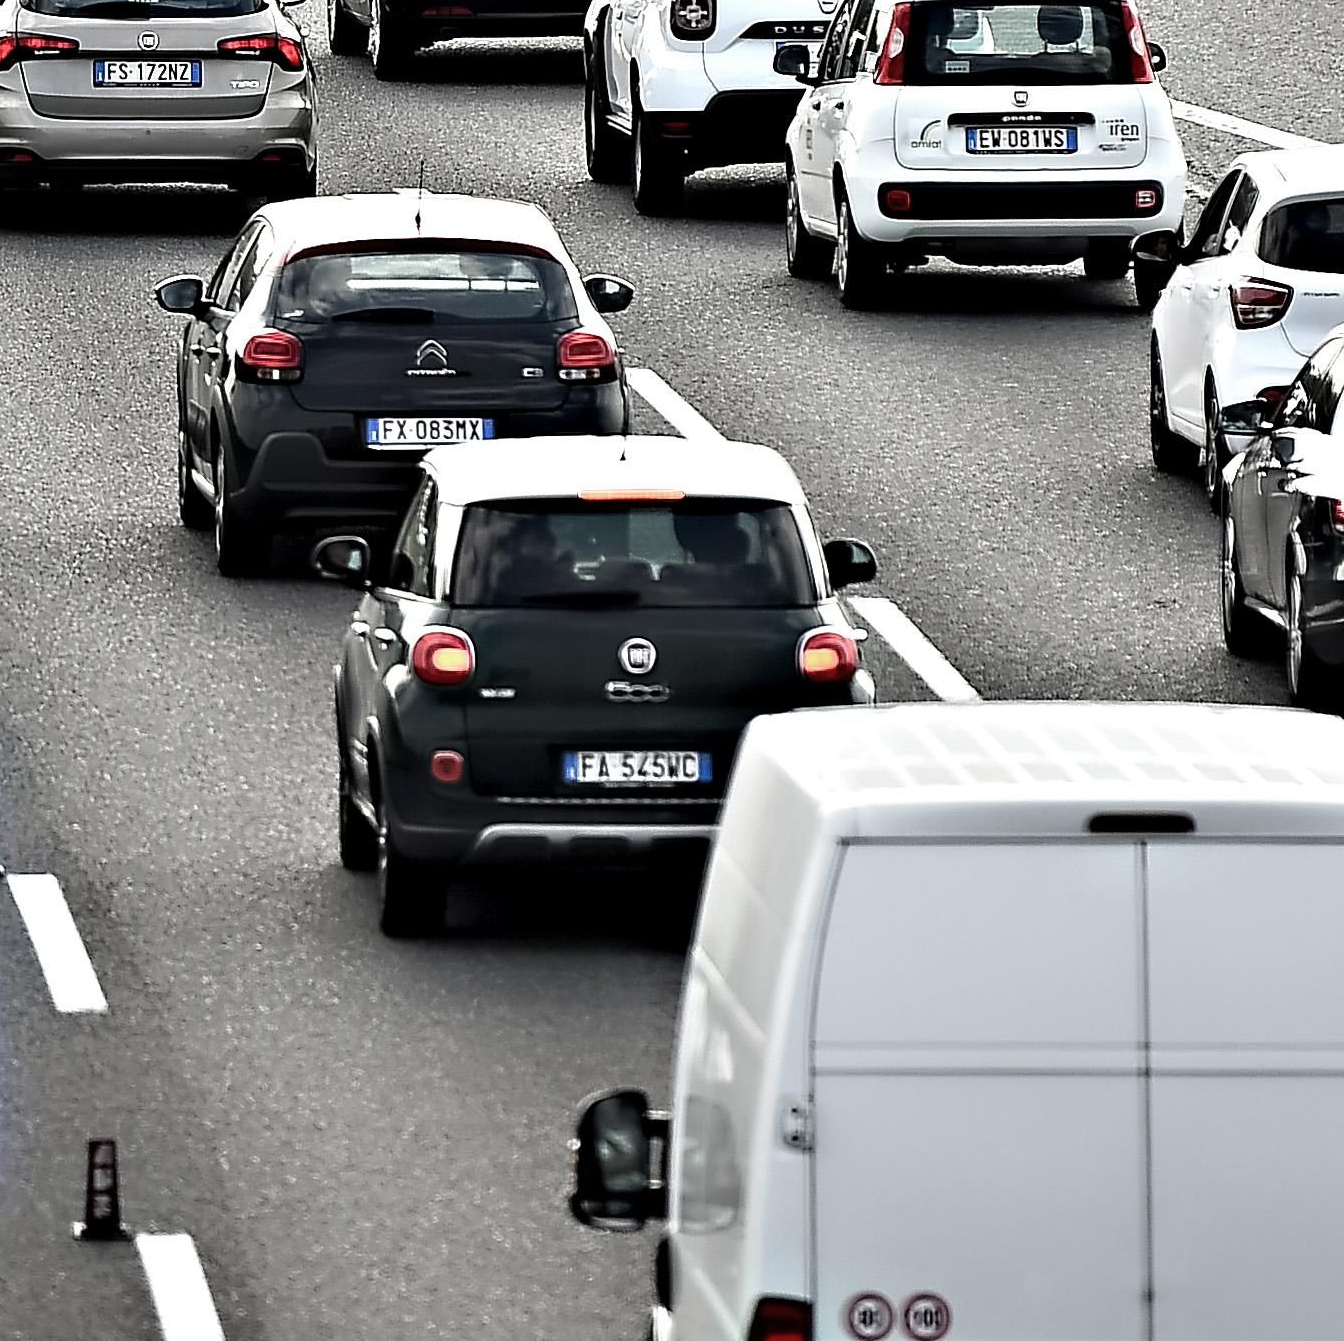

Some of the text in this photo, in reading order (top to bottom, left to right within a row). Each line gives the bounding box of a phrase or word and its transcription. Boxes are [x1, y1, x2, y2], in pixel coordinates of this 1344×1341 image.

[107, 63, 189, 81] FS 172NZ
[230, 80, 260, 89] TIPO
[1109, 123, 1140, 136] iren
[980, 130, 1065, 148] EW 081WS
[383, 419, 481, 441] FX 083MX
[581, 754, 697, 779] FA 545WC
